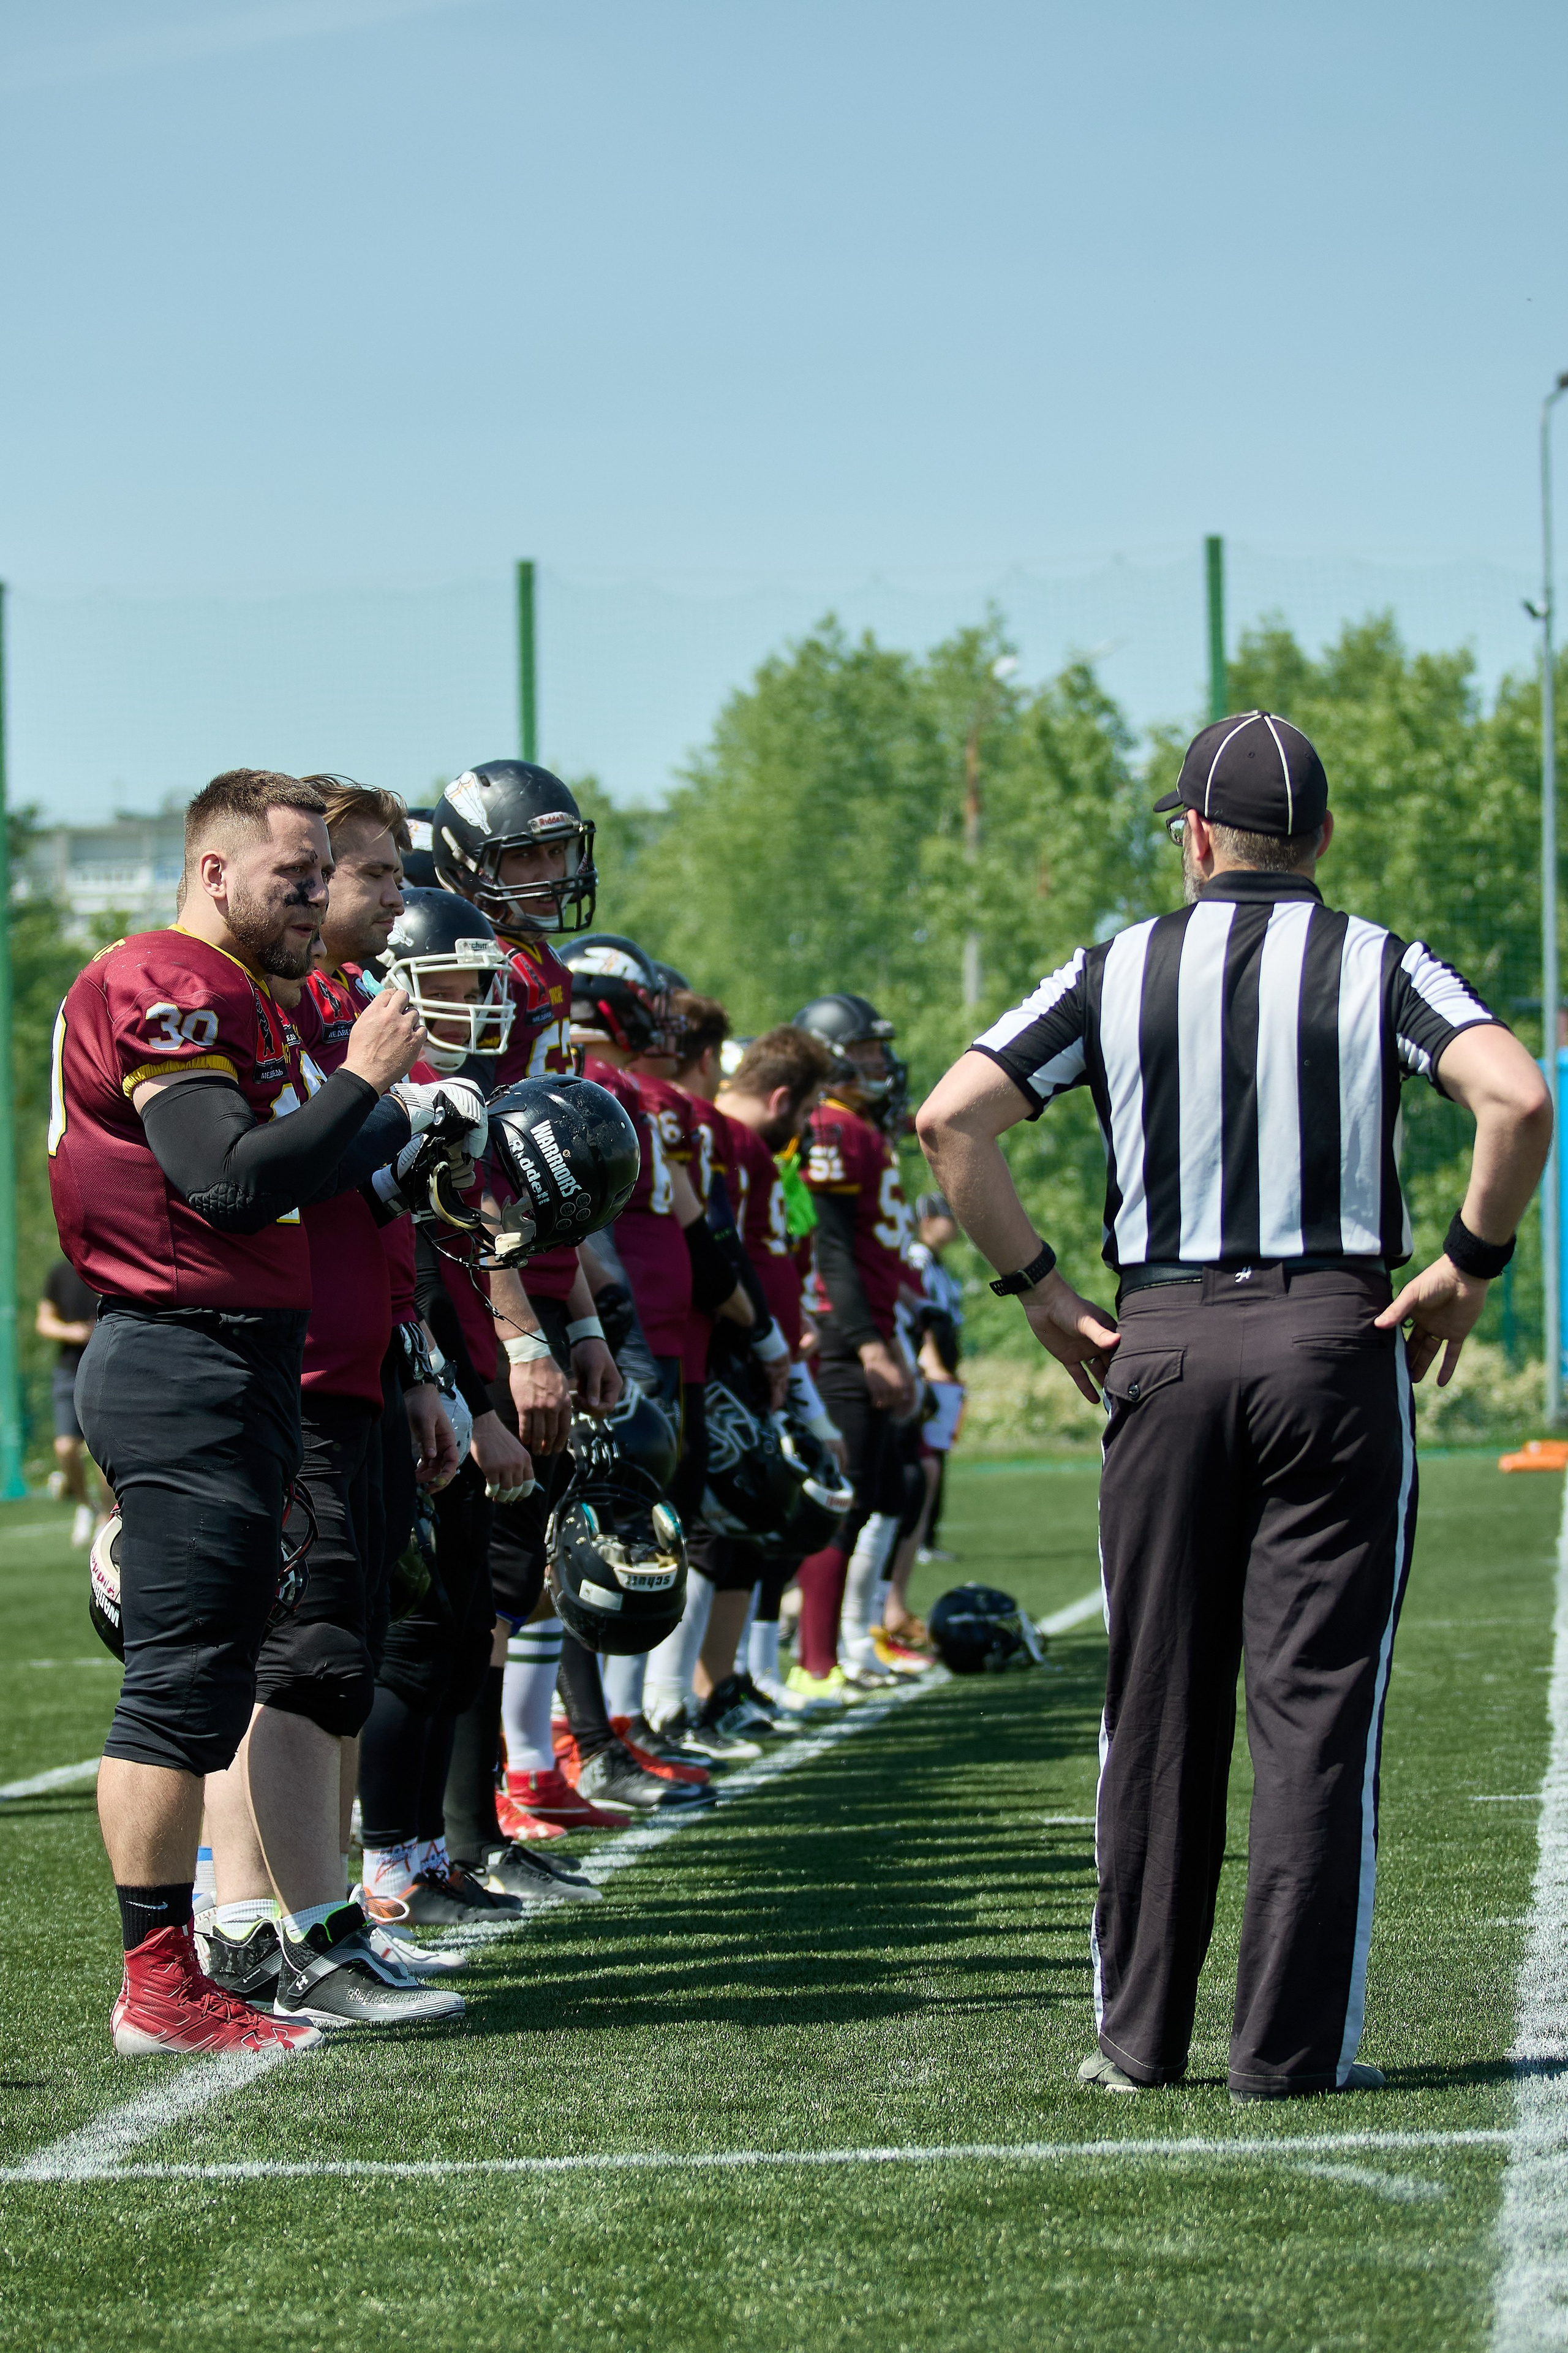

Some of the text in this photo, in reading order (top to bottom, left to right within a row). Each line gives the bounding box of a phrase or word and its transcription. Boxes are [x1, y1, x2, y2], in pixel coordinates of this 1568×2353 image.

[539, 814, 565, 826] Riddell
[145, 1002, 219, 1051] 30
[530, 1120, 582, 1198] WARRIORS
[626, 1575, 671, 1588] schutt
